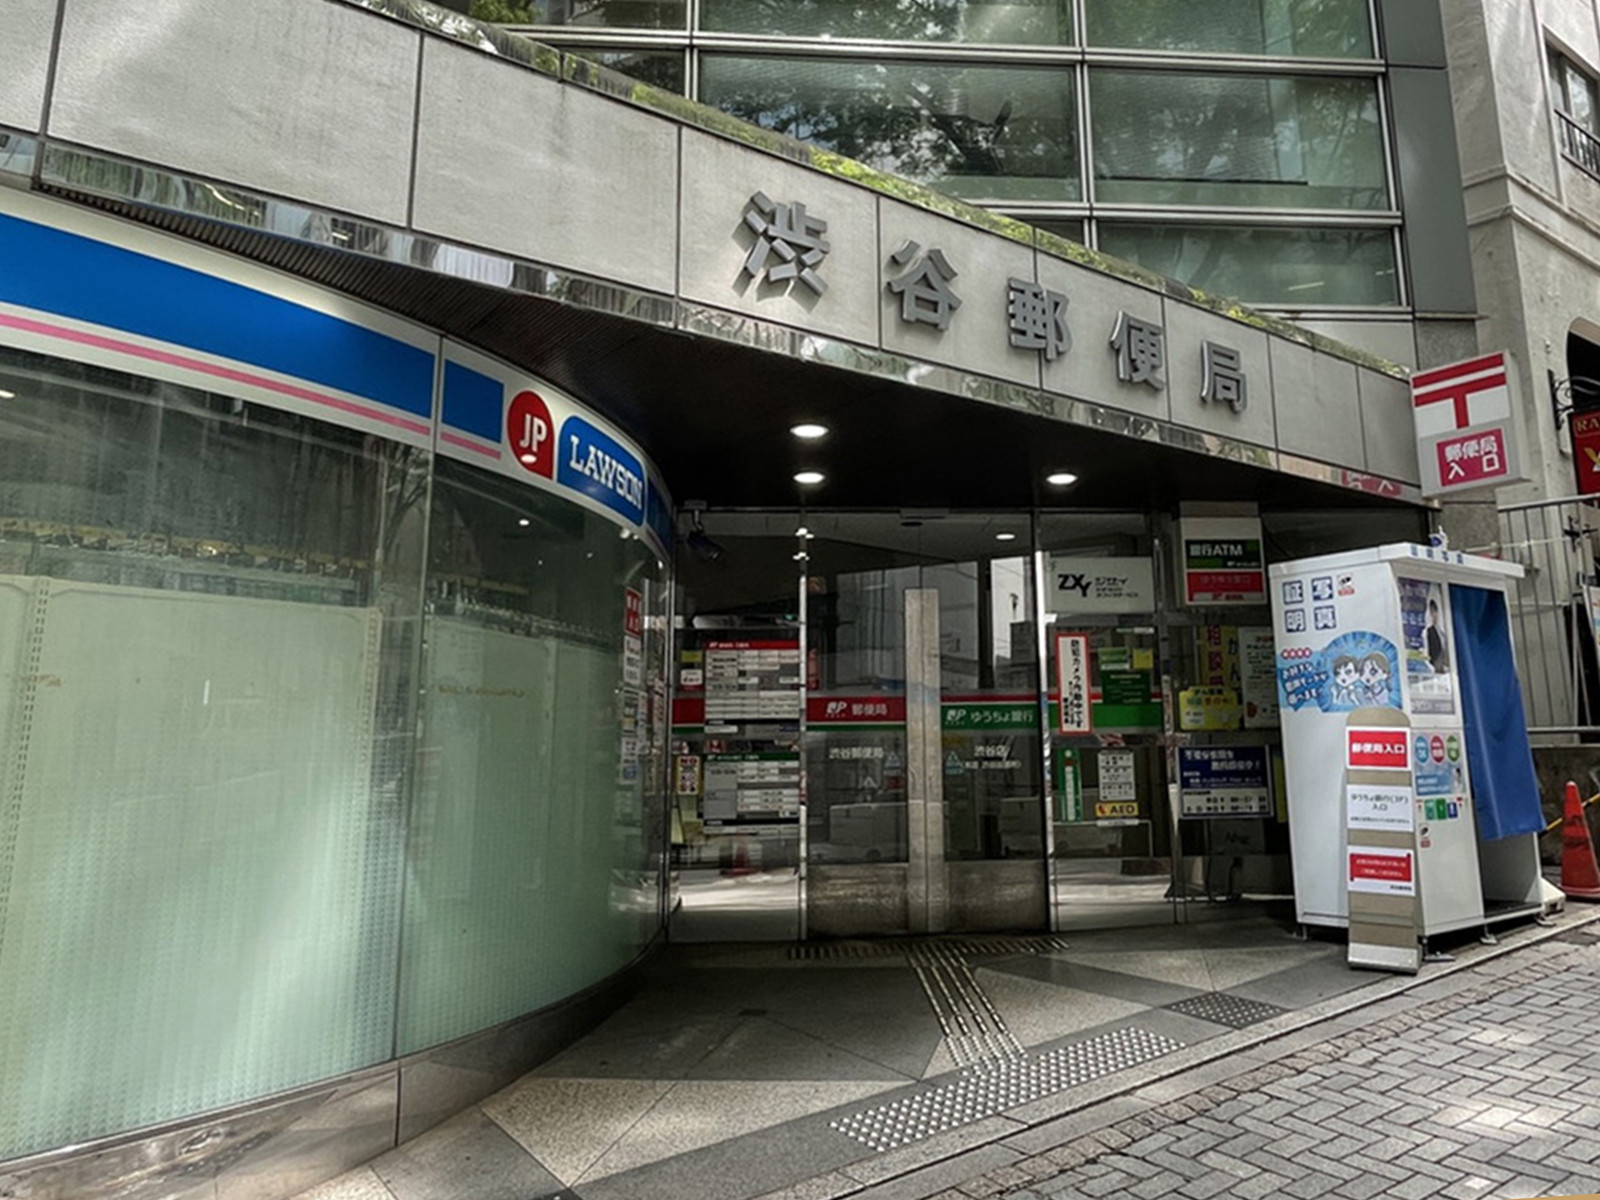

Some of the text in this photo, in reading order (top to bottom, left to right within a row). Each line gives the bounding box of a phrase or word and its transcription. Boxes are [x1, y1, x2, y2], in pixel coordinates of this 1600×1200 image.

[743, 190, 1248, 412] 渋谷郵便局
[519, 413, 548, 453] JP
[1445, 435, 1498, 462] 郵便局
[569, 434, 643, 510] LAWSON
[1448, 453, 1500, 481] 入口
[1190, 544, 1244, 557] 銀行ATM
[852, 703, 888, 716] 郵便局
[971, 710, 1034, 723] ゆうちょ銀行
[1351, 743, 1405, 754] 郵便局入口
[1110, 805, 1135, 815] AED
